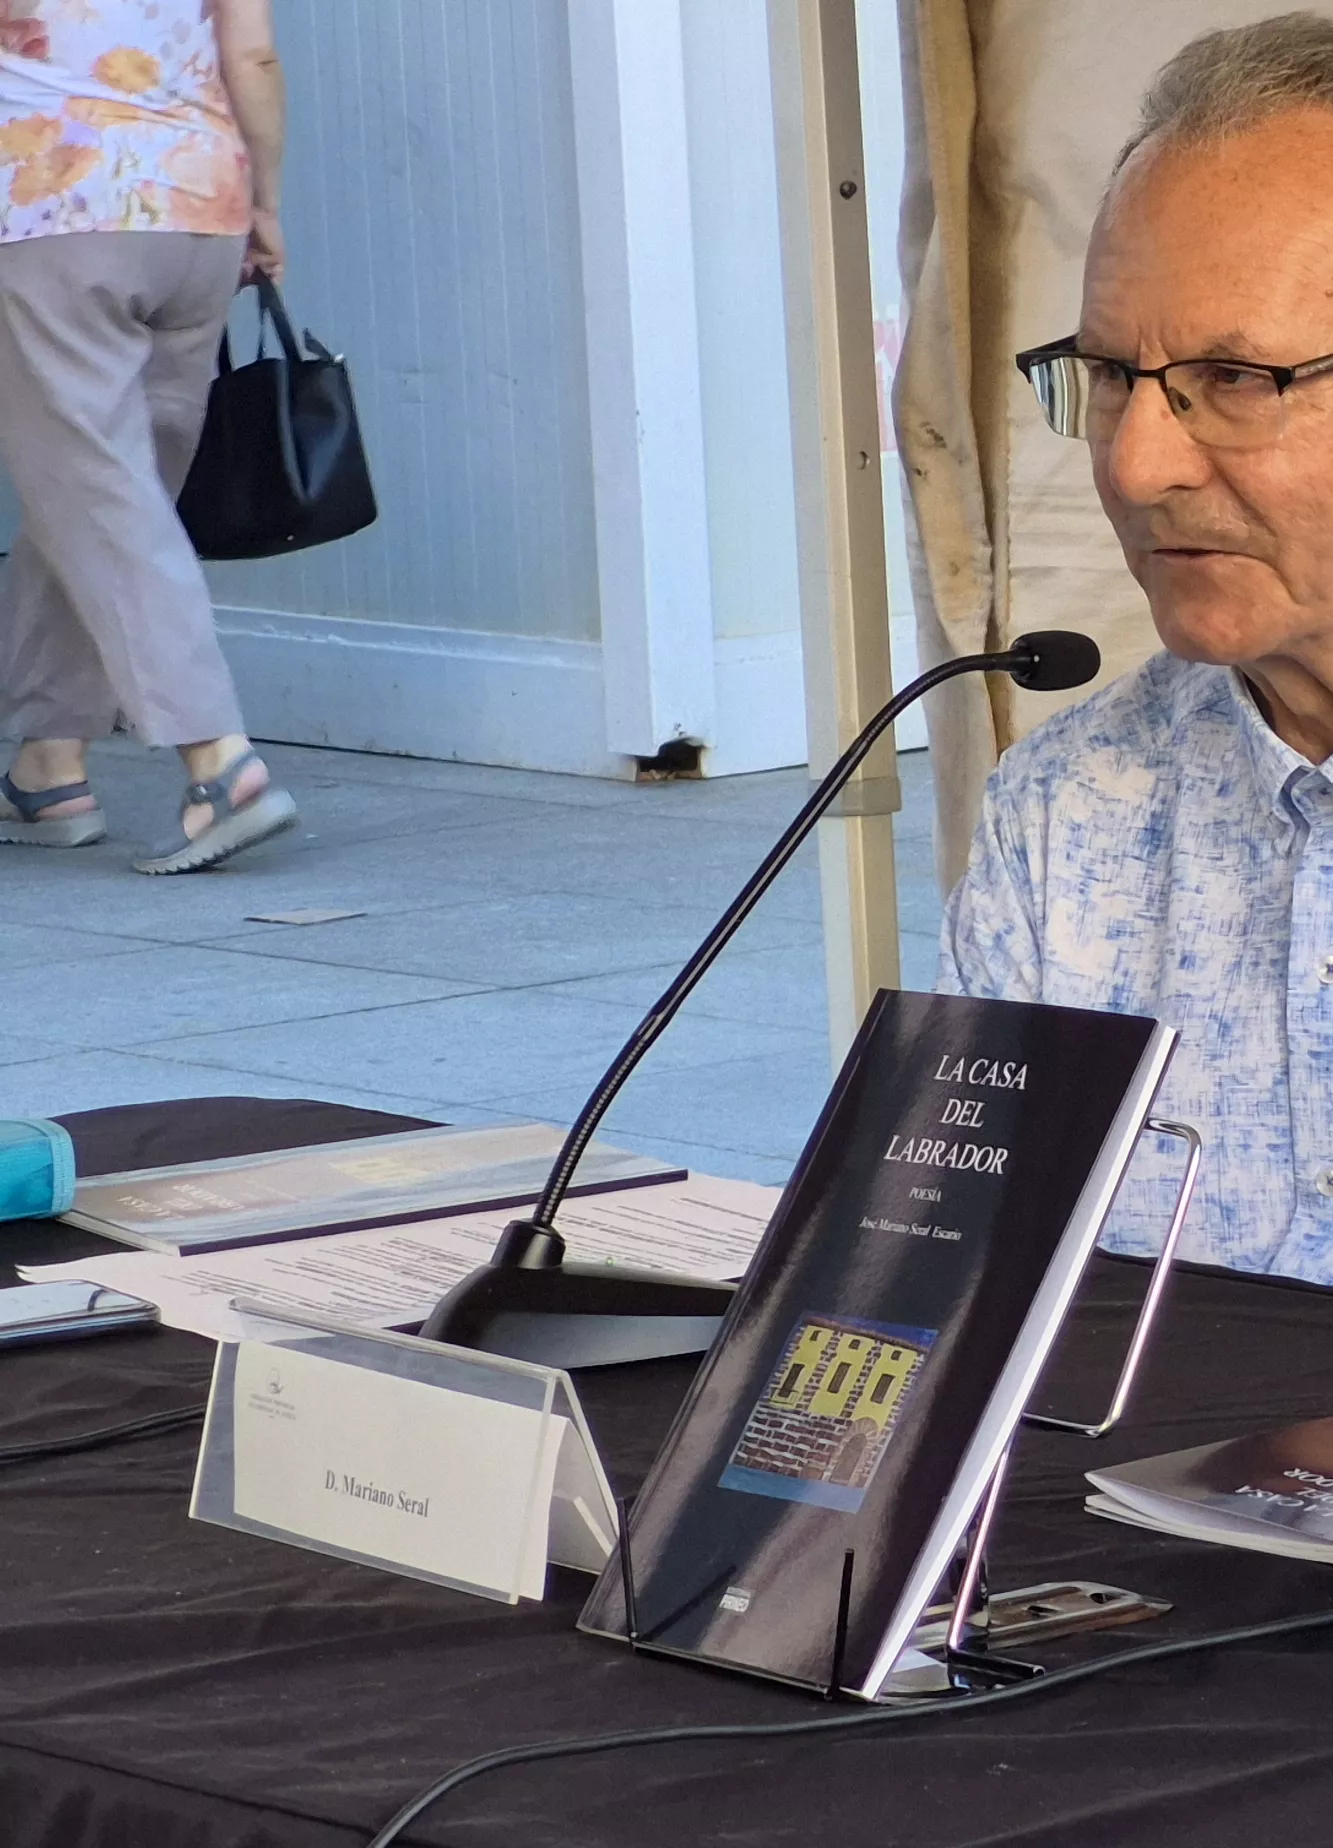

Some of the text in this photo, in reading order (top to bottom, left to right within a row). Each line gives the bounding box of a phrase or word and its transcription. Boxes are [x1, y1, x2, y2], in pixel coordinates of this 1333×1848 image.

[934, 1054, 1028, 1090] LA CASA
[939, 1098, 985, 1128] DEL
[883, 1135, 1008, 1174] LABRADOR
[325, 1469, 429, 1518] D. Mariano Seral
